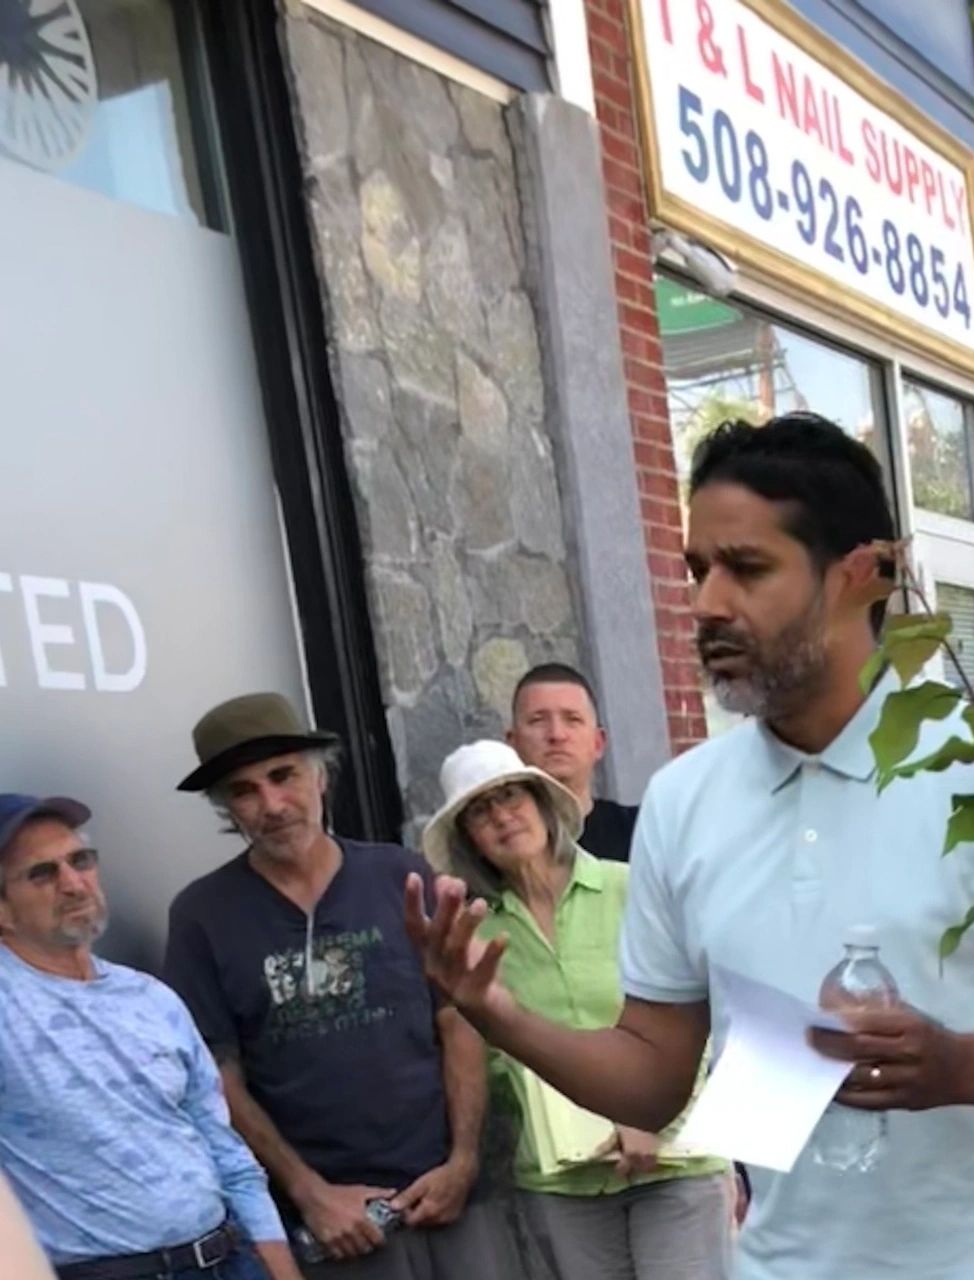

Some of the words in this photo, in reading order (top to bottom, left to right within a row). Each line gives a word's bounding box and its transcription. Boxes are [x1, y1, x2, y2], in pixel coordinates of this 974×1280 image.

[677, 82, 971, 330] 508-926-8854
[695, 0, 728, 78] &
[736, 23, 765, 105] L
[771, 49, 856, 167] NAIL
[860, 117, 966, 237] SUPPLY
